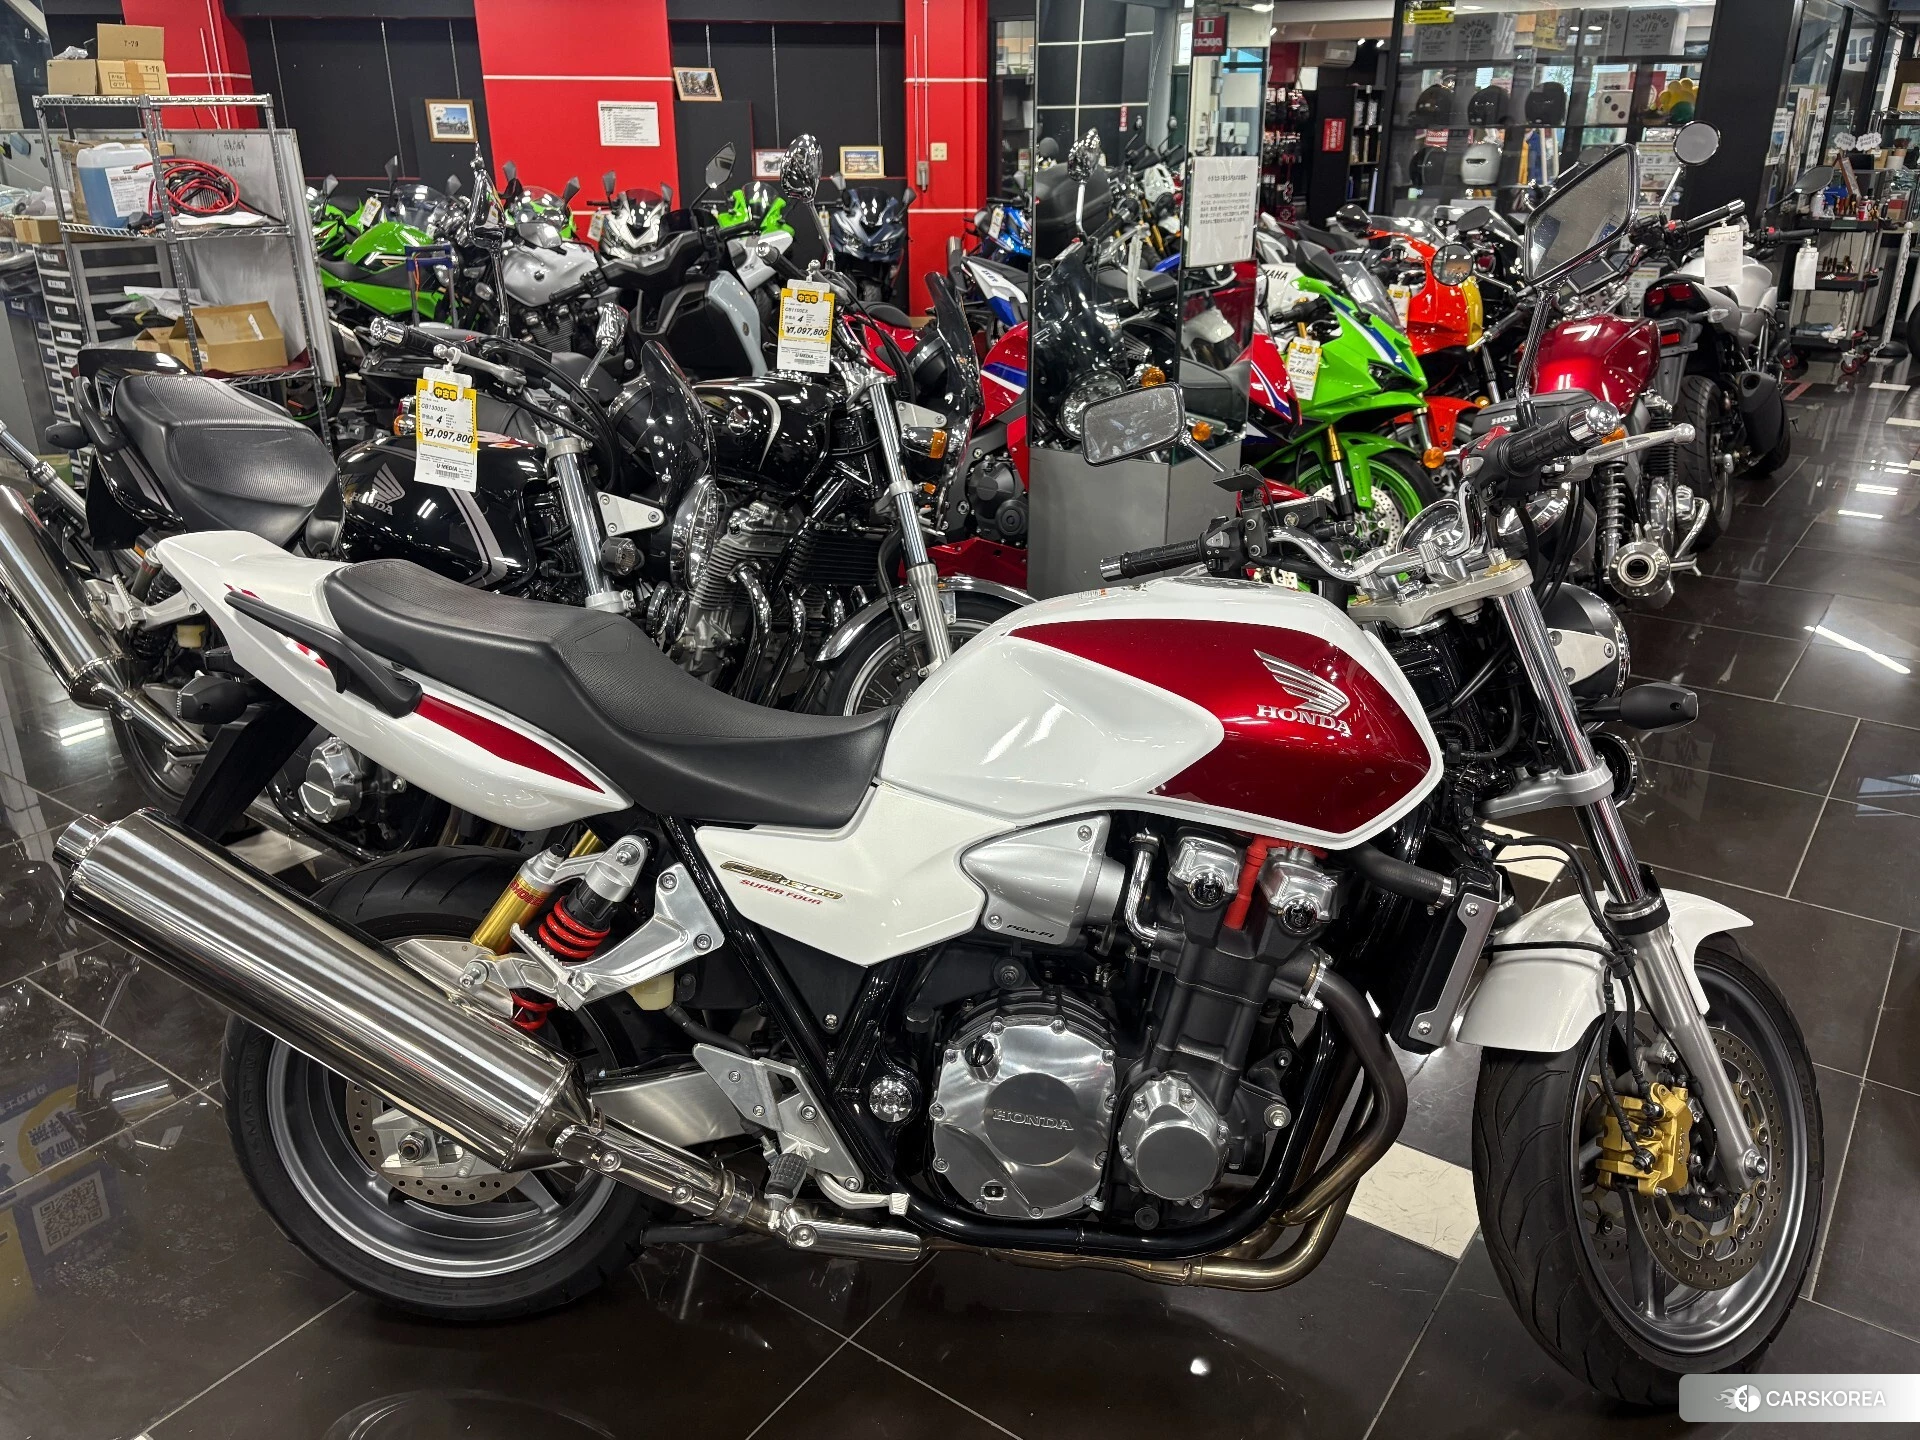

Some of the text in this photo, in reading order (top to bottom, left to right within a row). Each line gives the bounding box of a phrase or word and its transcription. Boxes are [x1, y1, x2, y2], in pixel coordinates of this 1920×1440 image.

[436, 415, 443, 424] 4
[1491, 415, 1518, 425] HON
[424, 428, 474, 444] ¥1,097,800
[1256, 704, 1352, 737] HONDA
[740, 879, 823, 905] SUPER FOUR
[1006, 924, 1055, 938] PGM-FI
[992, 1107, 1074, 1131] HONDA
